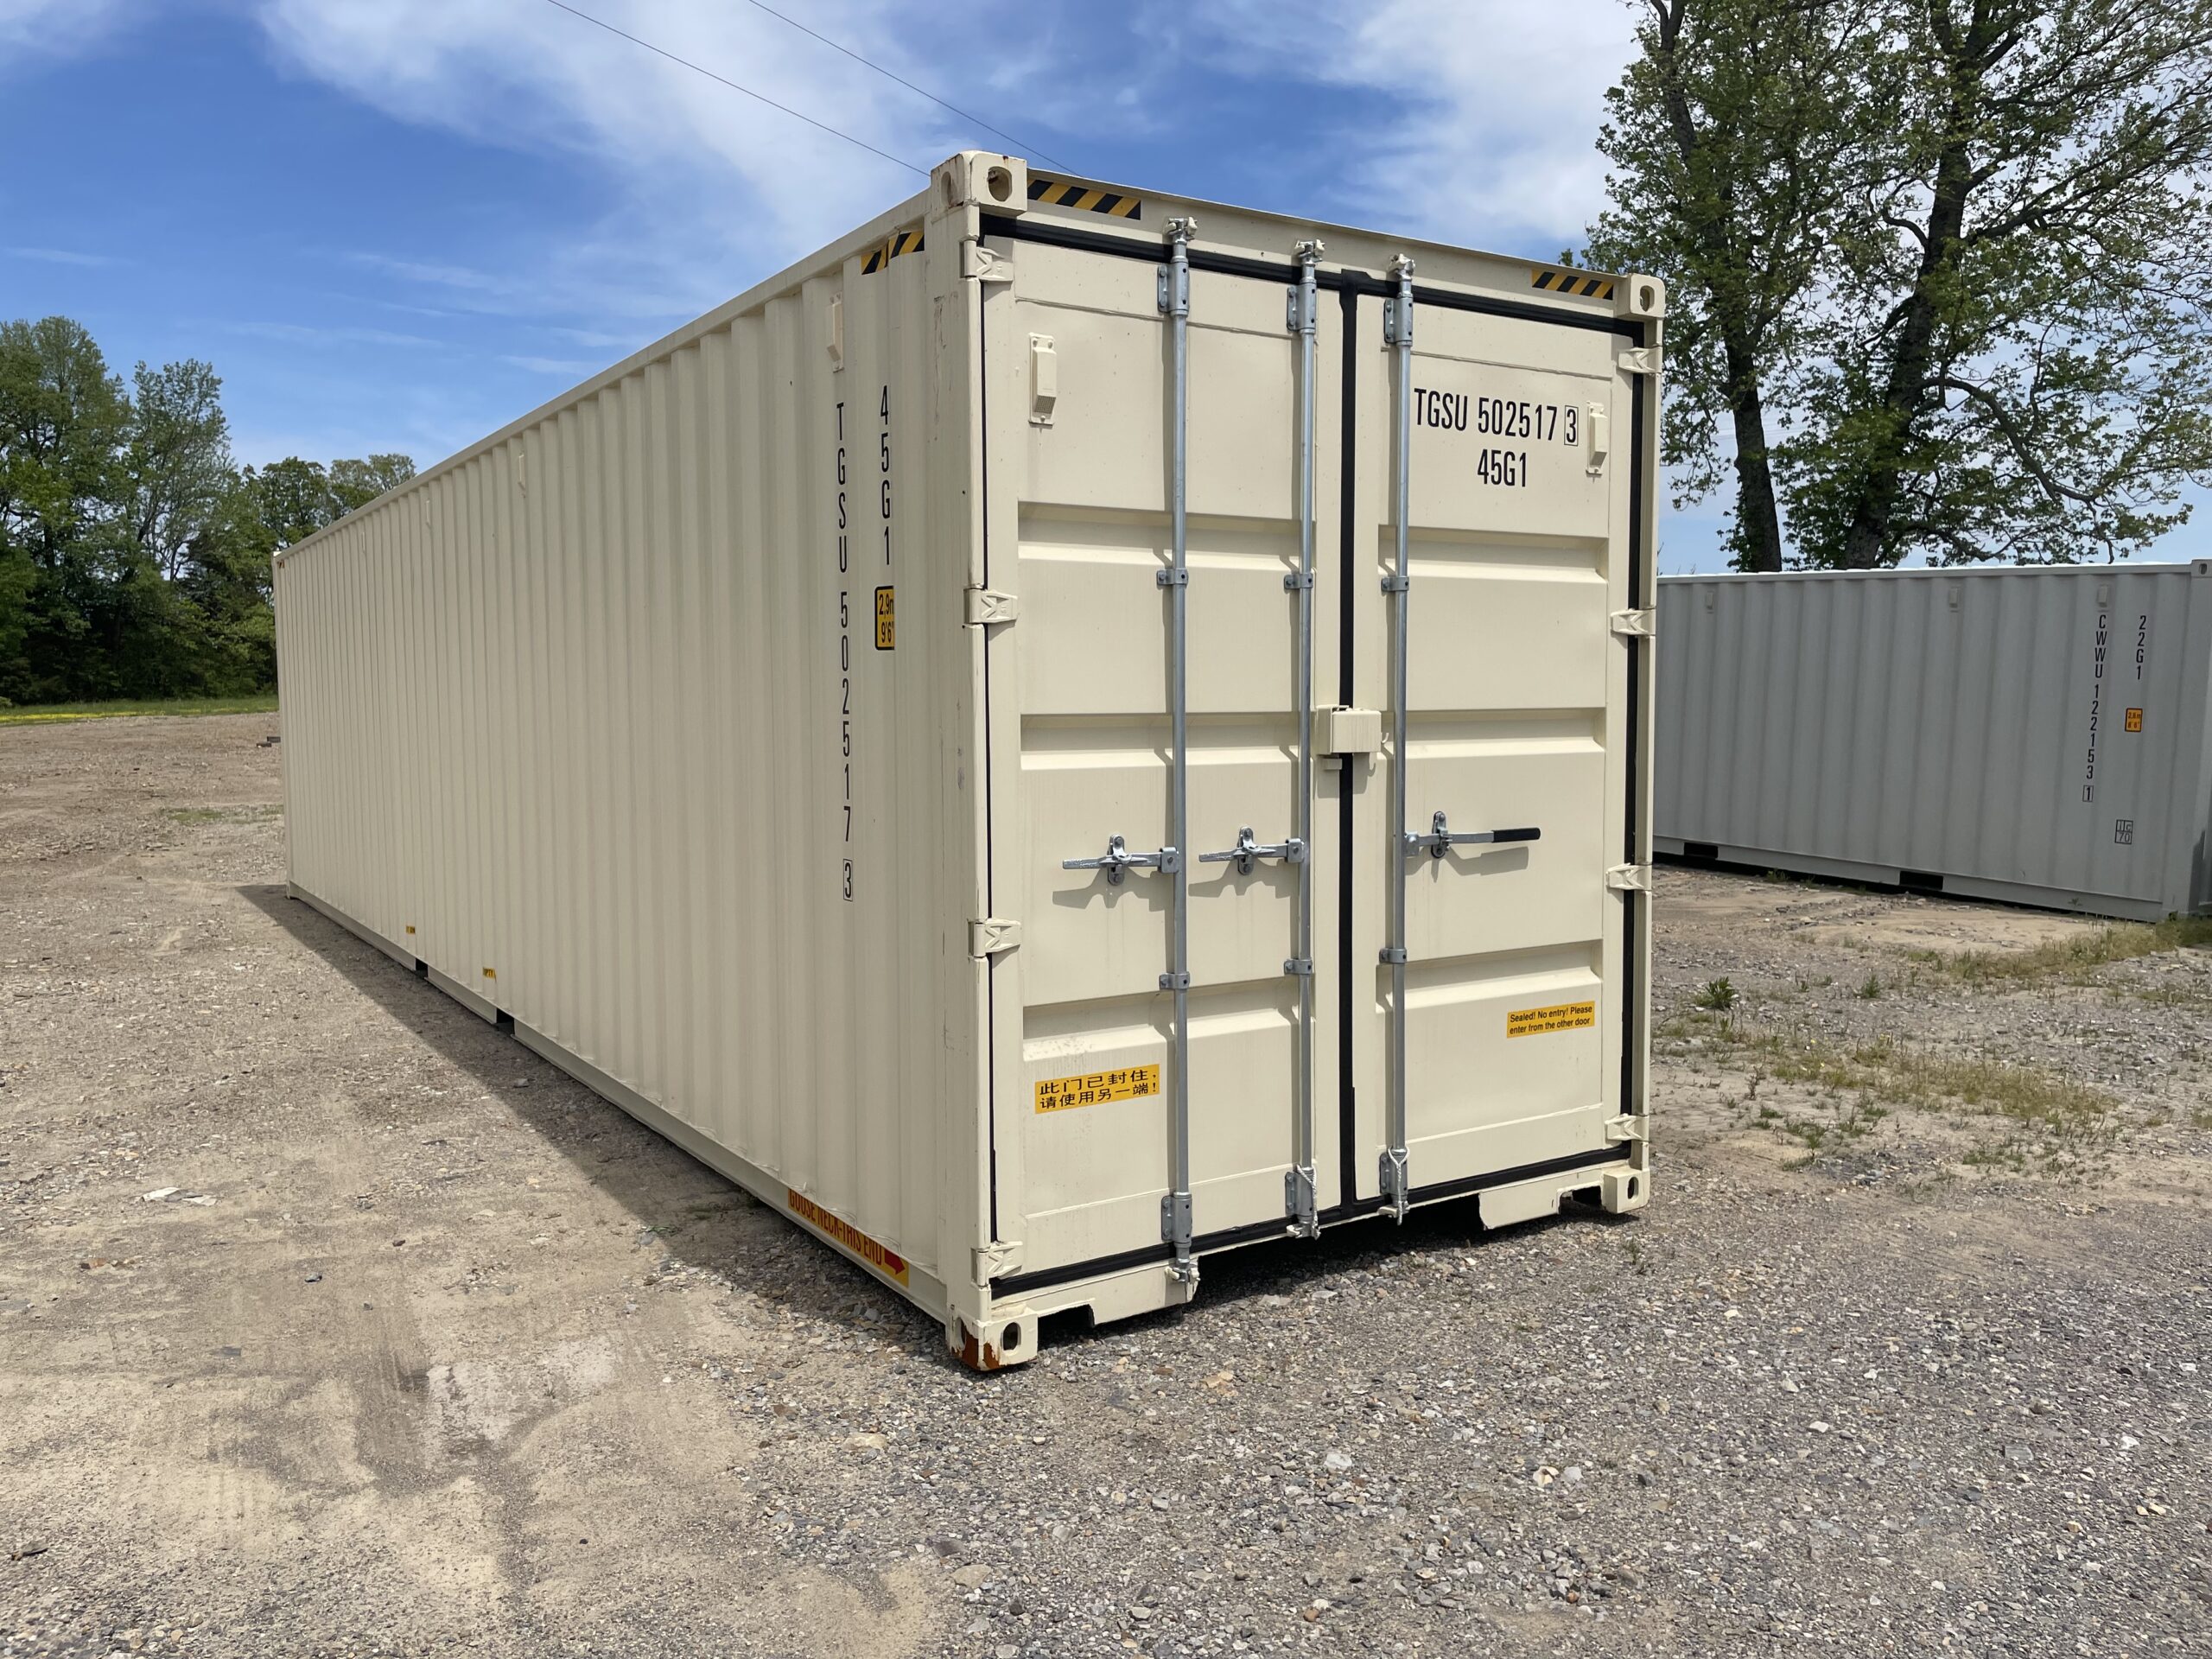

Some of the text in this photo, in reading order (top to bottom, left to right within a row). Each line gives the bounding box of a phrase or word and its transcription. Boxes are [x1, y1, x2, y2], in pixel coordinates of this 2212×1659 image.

[1414, 387, 1577, 443] TGSU 502517 3
[880, 385, 891, 566] 45G1
[1477, 448, 1527, 487] 45G1
[836, 402, 852, 899] TGSU 502517 3
[2094, 614, 2107, 679] CWWU
[2135, 614, 2147, 680] 22G1
[2086, 683, 2100, 779] 122153
[1510, 1006, 1592, 1023] Sealed! No entry! Please
[1510, 1017, 1591, 1034] enter from the other door
